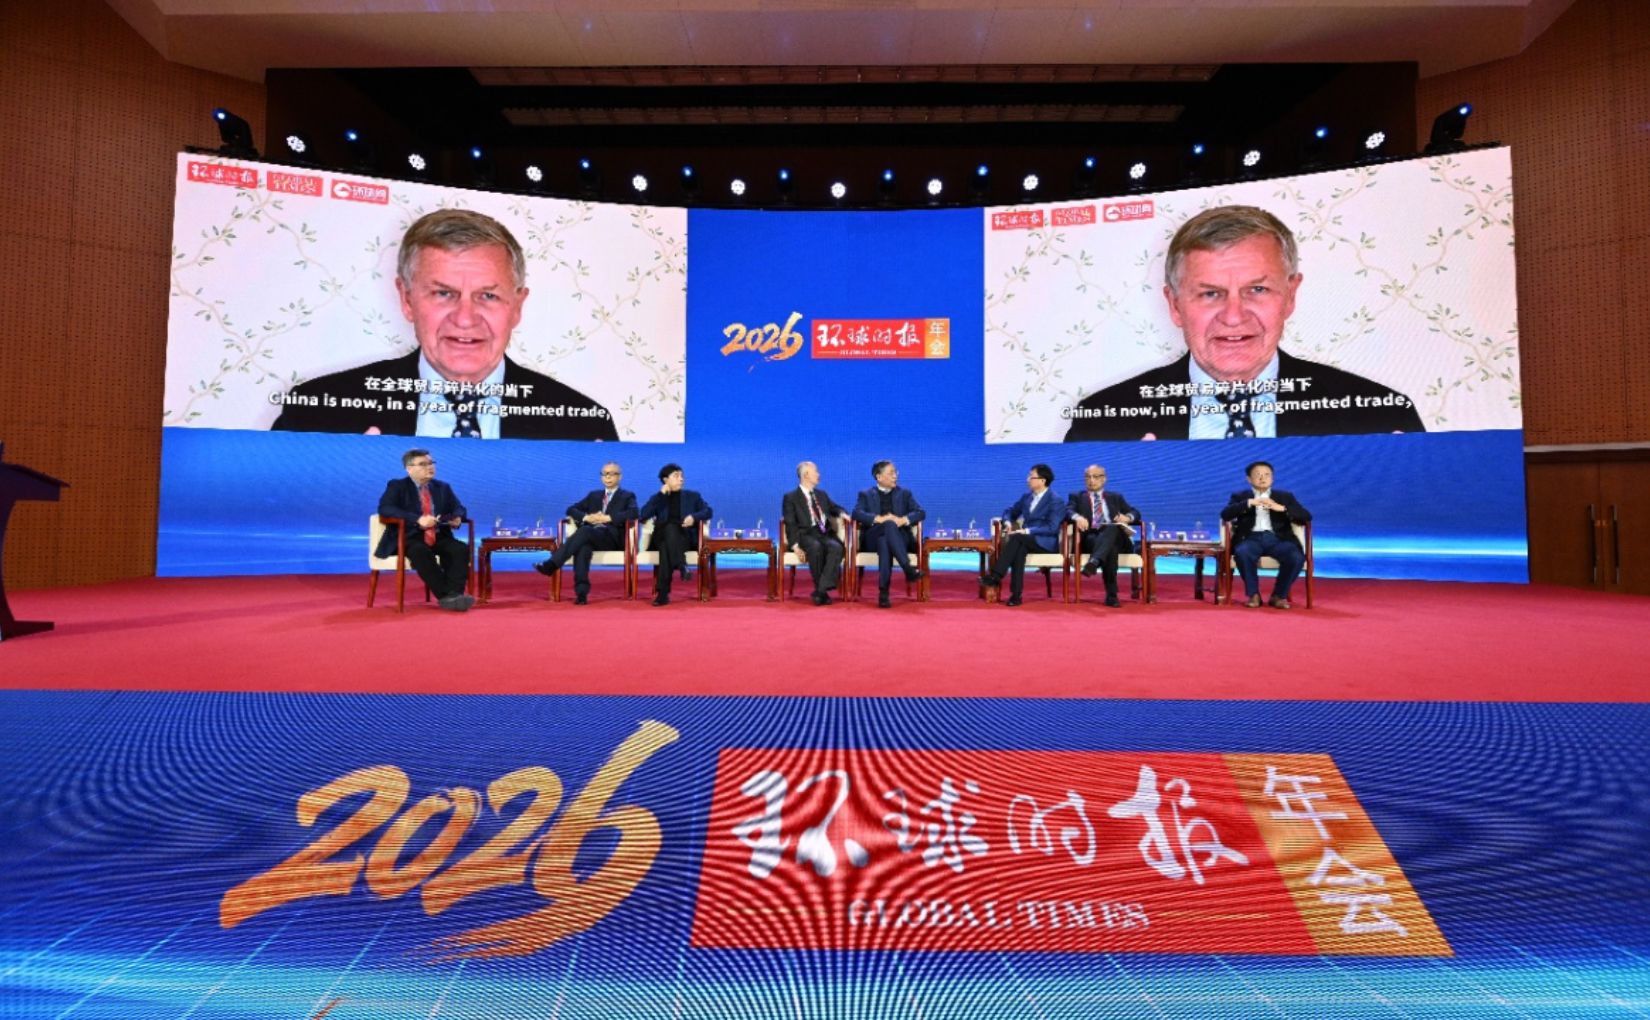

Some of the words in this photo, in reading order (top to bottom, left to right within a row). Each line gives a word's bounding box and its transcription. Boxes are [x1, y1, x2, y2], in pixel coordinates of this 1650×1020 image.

[720, 311, 804, 361] 2026
[816, 321, 921, 347] 环球时报
[364, 376, 534, 398] 在全球贸易碎片化的当下
[1139, 377, 1312, 398] 在全球贸易碎片化的当下
[269, 391, 319, 406] China
[323, 393, 337, 407] is
[341, 397, 383, 412] now,
[387, 397, 402, 410] in
[405, 401, 416, 411] a
[420, 401, 453, 414] year
[458, 400, 475, 413] of
[476, 402, 565, 417] fragmented
[567, 405, 611, 420] trade,
[1060, 405, 1101, 418] China
[1104, 405, 1117, 417] is
[1120, 406, 1157, 418] now,
[1160, 403, 1175, 416] in
[1178, 406, 1188, 415] a
[1191, 403, 1227, 418] year
[1230, 399, 1247, 413] of
[1251, 396, 1351, 415] fragmented
[1355, 393, 1413, 409] trade,
[731, 765, 1250, 885] 环球时报
[219, 719, 680, 966] 2026
[1262, 766, 1408, 937] 年会
[848, 899, 1013, 928] GLOBAL
[1016, 900, 1151, 928] TIMES
